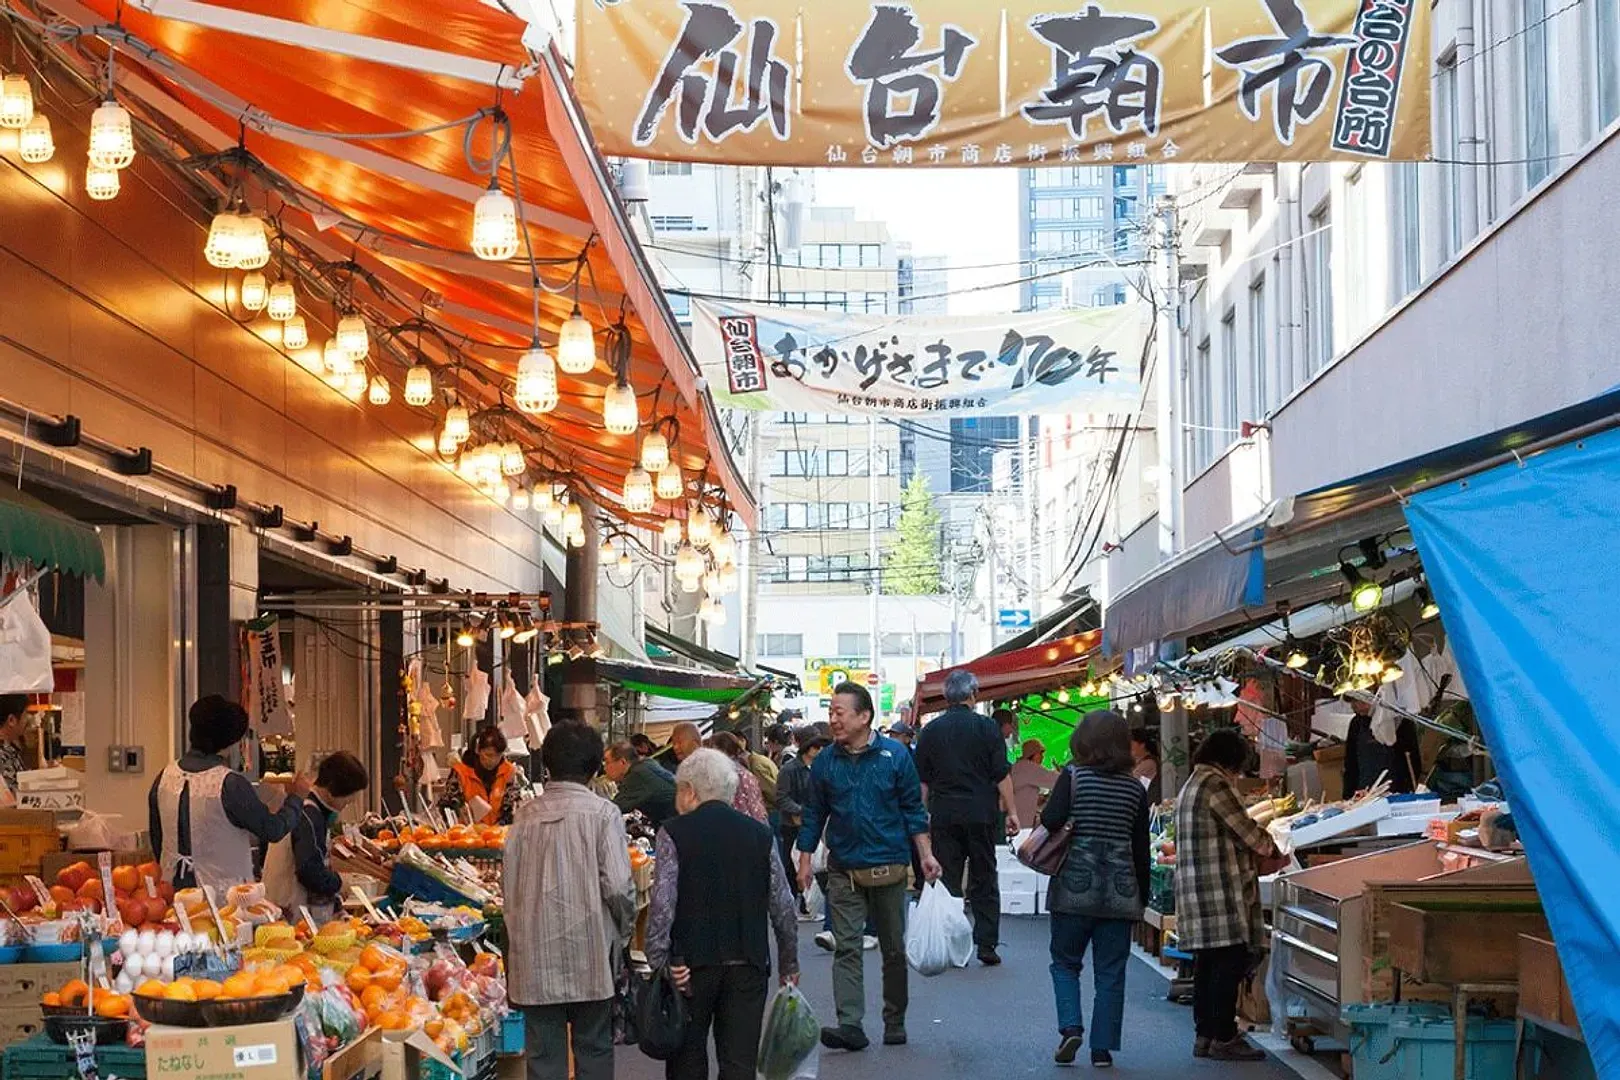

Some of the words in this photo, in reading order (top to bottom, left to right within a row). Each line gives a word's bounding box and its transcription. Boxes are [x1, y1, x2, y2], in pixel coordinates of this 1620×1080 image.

[633, 0, 1358, 150] 仙台朝市
[1338, 0, 1407, 149] 台の台所
[826, 140, 1180, 163] 仙台朝市商店街振興組合
[724, 320, 759, 389] 仙台朝市
[771, 327, 1118, 390] おかげさまで70年
[837, 393, 988, 411] 仙台朝市商店街振興組合
[157, 1053, 205, 1072] たねなし
